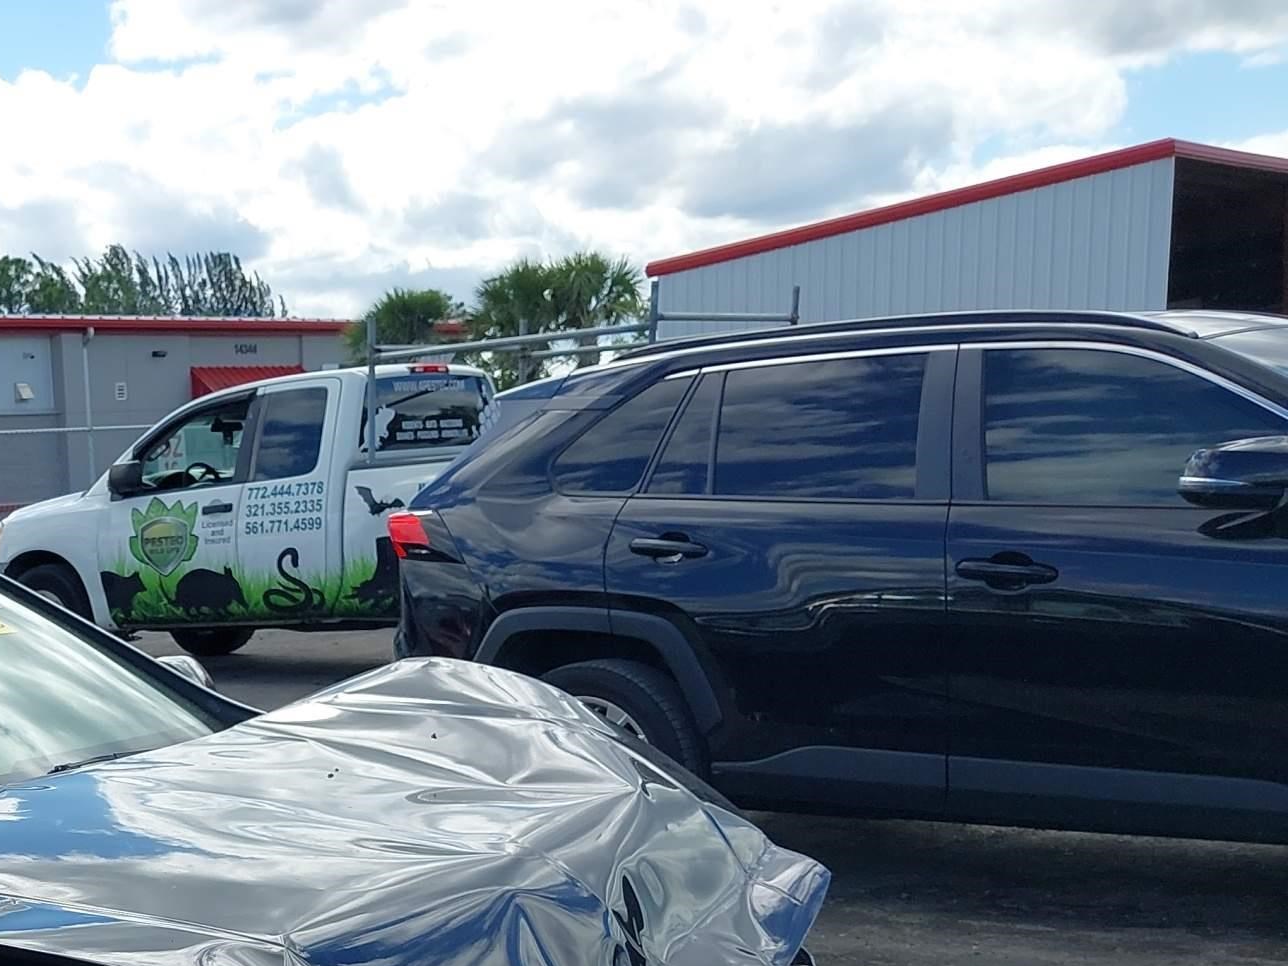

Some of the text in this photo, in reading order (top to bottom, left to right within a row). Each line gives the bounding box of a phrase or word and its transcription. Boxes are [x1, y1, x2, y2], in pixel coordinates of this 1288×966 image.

[247, 481, 324, 500] 772.444.7378
[245, 499, 323, 518] 321.355.2335
[210, 528, 225, 537] and
[244, 516, 322, 535] 561.771.4599
